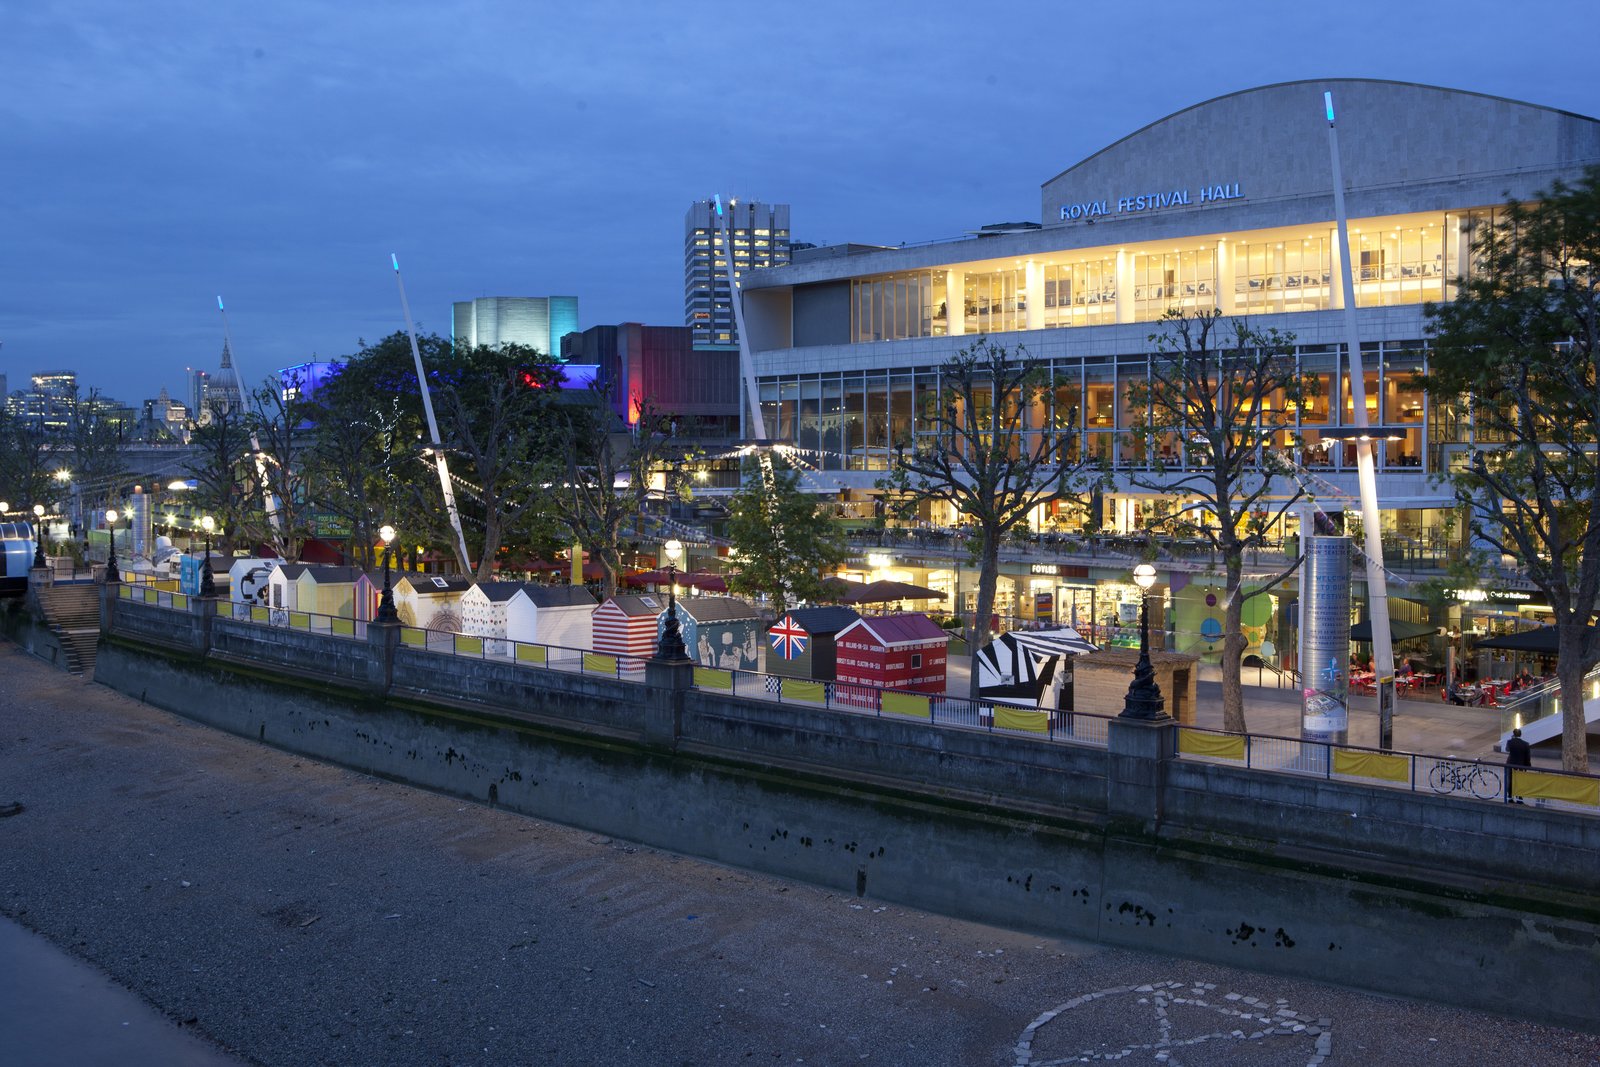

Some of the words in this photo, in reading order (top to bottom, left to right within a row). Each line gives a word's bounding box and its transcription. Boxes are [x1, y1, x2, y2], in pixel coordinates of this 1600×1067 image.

[1060, 200, 1110, 220] ROYAL
[1118, 189, 1193, 213] FESTIVAL
[1200, 183, 1245, 203] HALL
[1032, 564, 1057, 574] FOYLES
